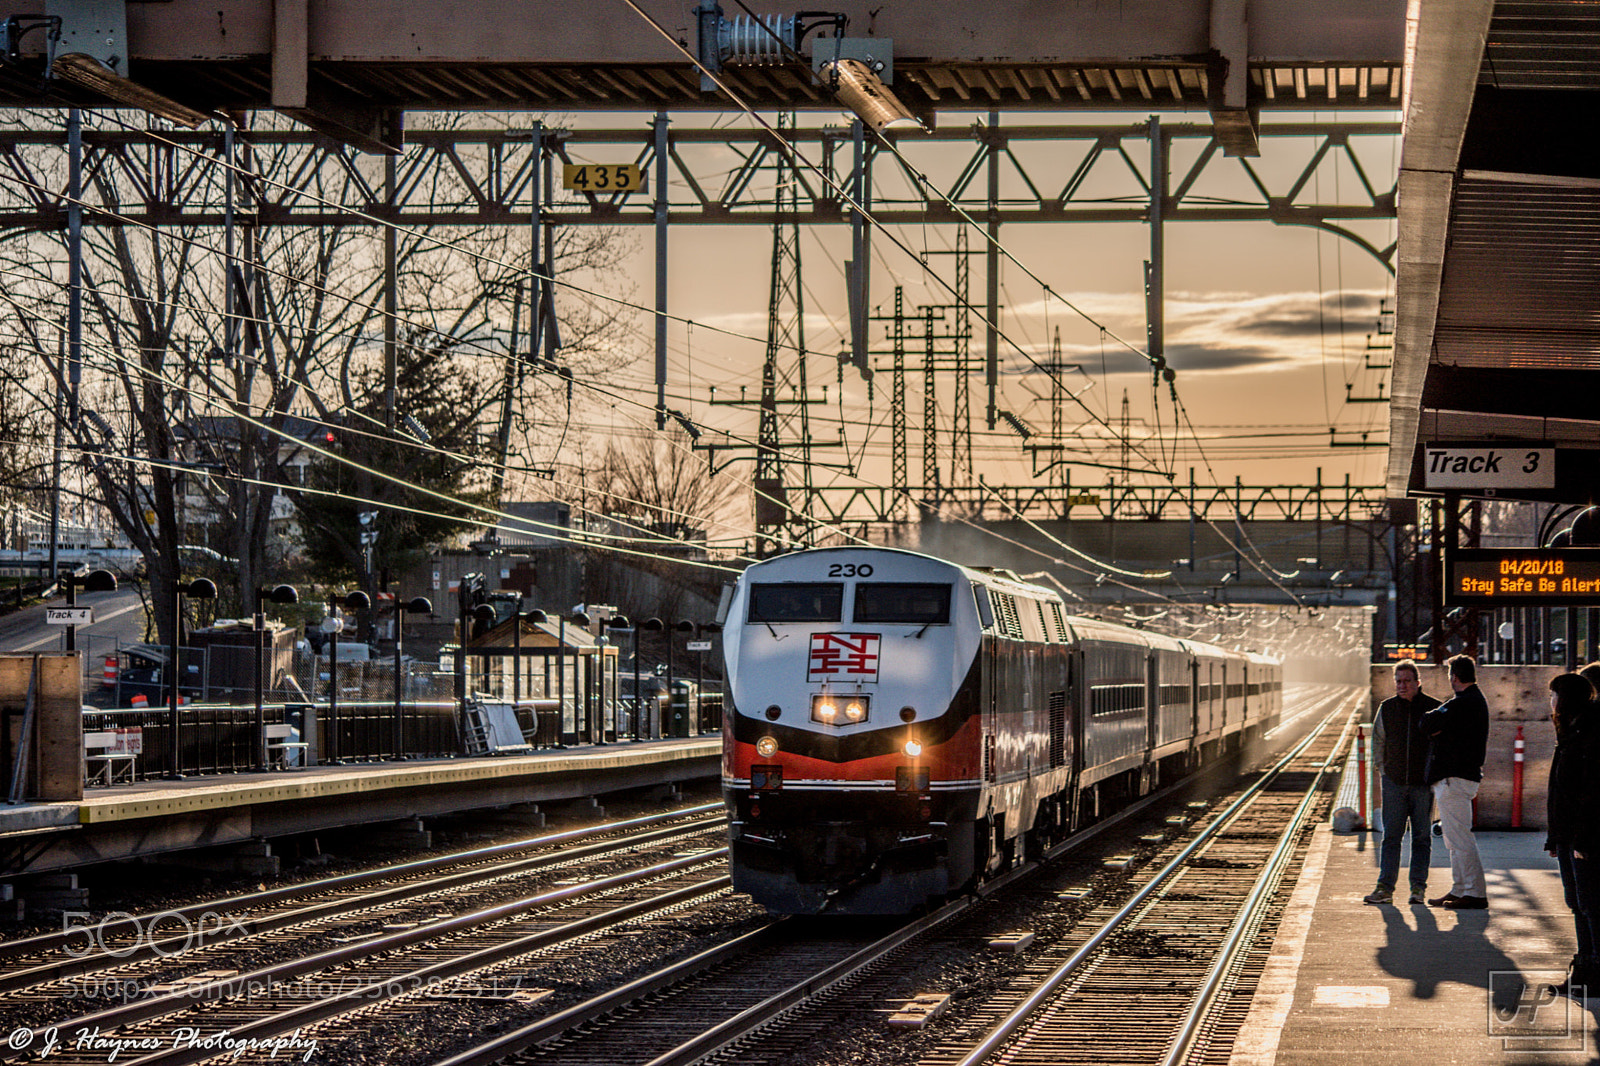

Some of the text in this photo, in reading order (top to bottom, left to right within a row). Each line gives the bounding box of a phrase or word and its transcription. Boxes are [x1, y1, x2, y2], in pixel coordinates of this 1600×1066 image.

[573, 166, 630, 189] 435
[1428, 451, 1540, 474] Track 3
[828, 563, 874, 578] 230
[1500, 560, 1564, 575] 04/20/18
[1461, 577, 1600, 596] Stay Safe Be Alert
[48, 610, 86, 619] Track 4
